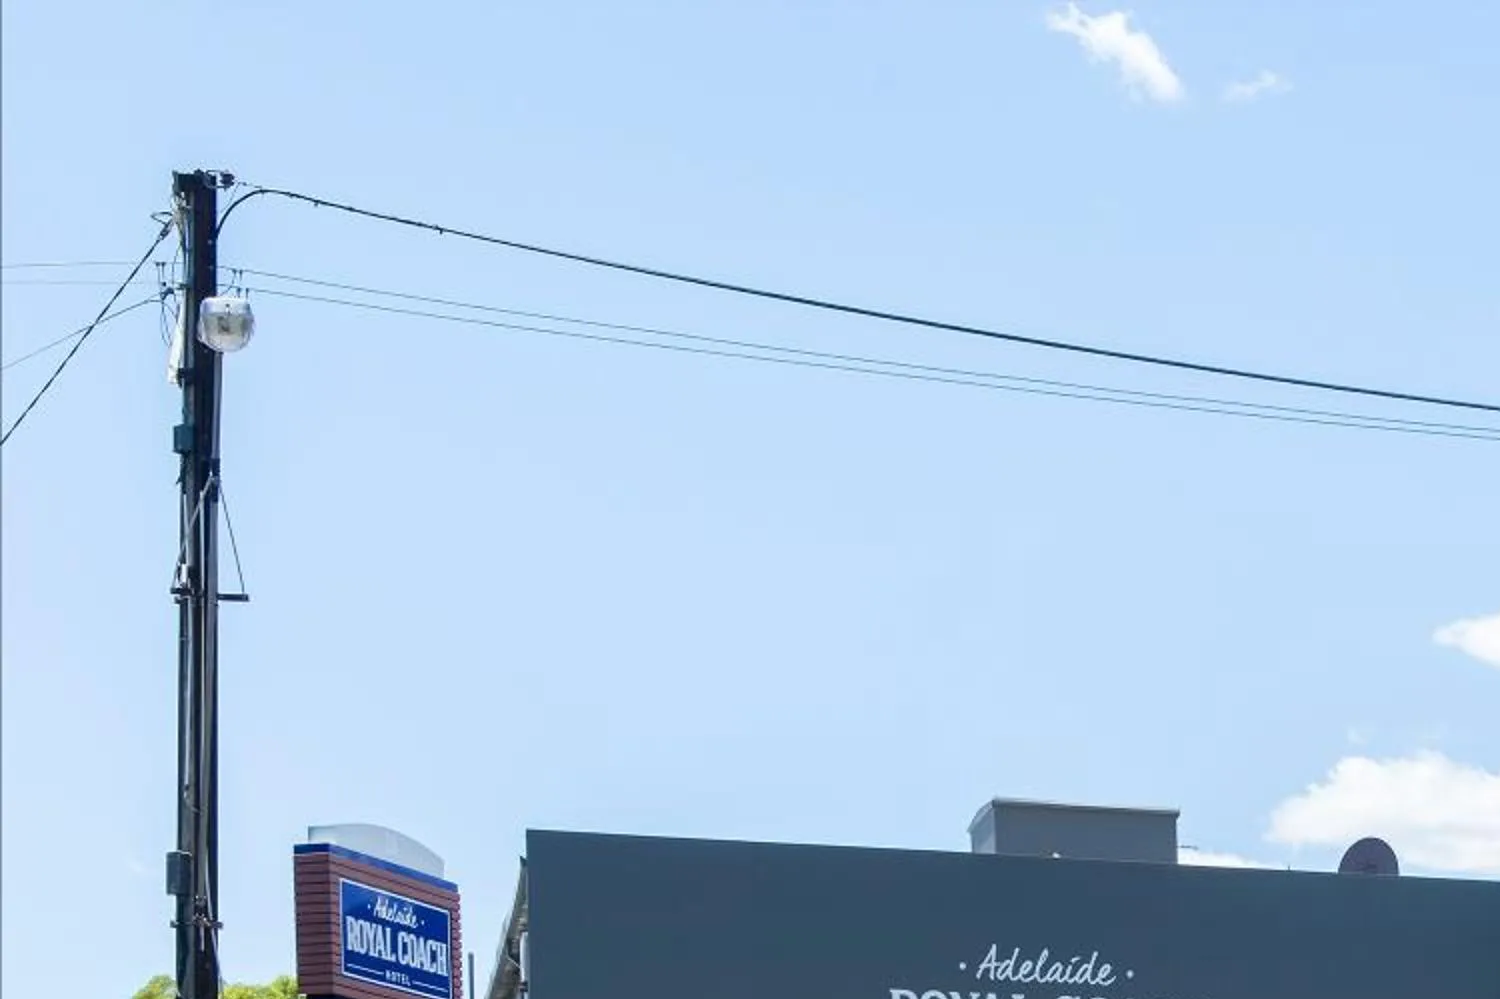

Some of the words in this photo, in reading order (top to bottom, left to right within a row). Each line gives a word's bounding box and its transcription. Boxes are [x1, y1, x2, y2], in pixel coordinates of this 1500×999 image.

[374, 895, 418, 928] Adelaide
[345, 915, 396, 962] ROYAL
[397, 931, 449, 976] COACH
[975, 943, 1117, 985] Adelaide
[385, 969, 411, 986] HOTEL
